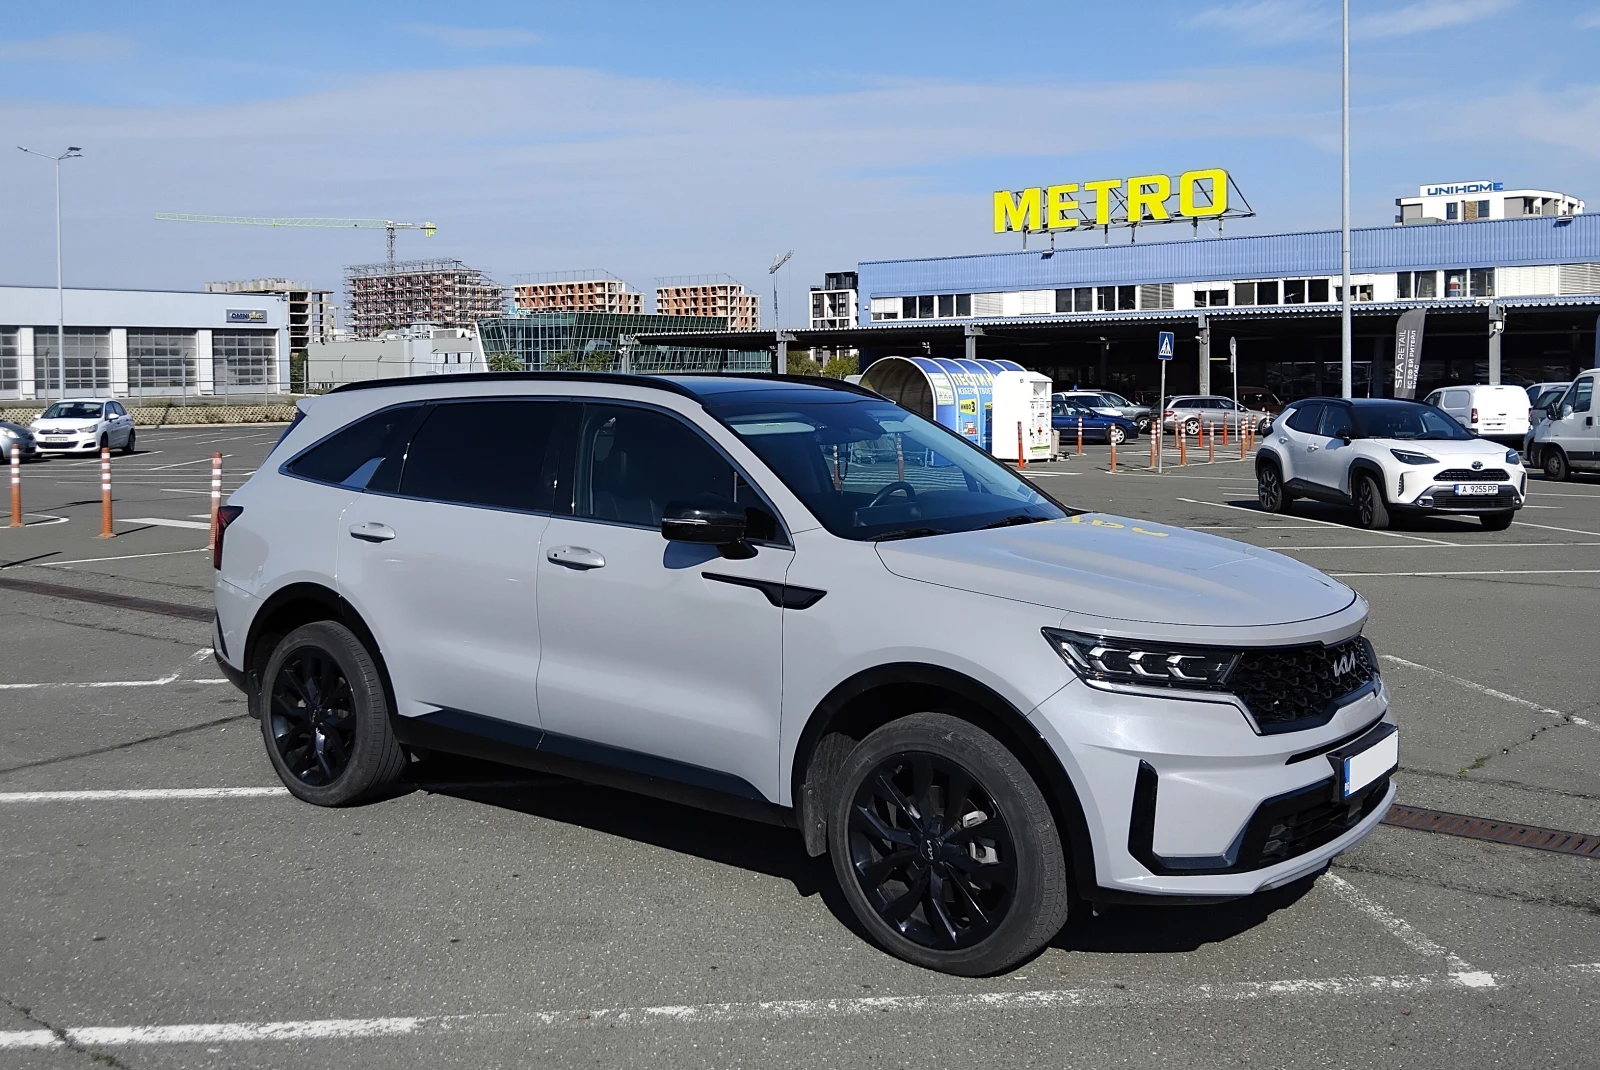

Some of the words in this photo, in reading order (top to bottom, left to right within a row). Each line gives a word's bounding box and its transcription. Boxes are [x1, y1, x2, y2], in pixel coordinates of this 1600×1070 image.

[993, 168, 1229, 234] METRO
[1427, 182, 1503, 196] UNIHOME
[1398, 330, 1406, 359] RETAIL
[1395, 363, 1404, 388] SFA
[971, 401, 976, 412] 3
